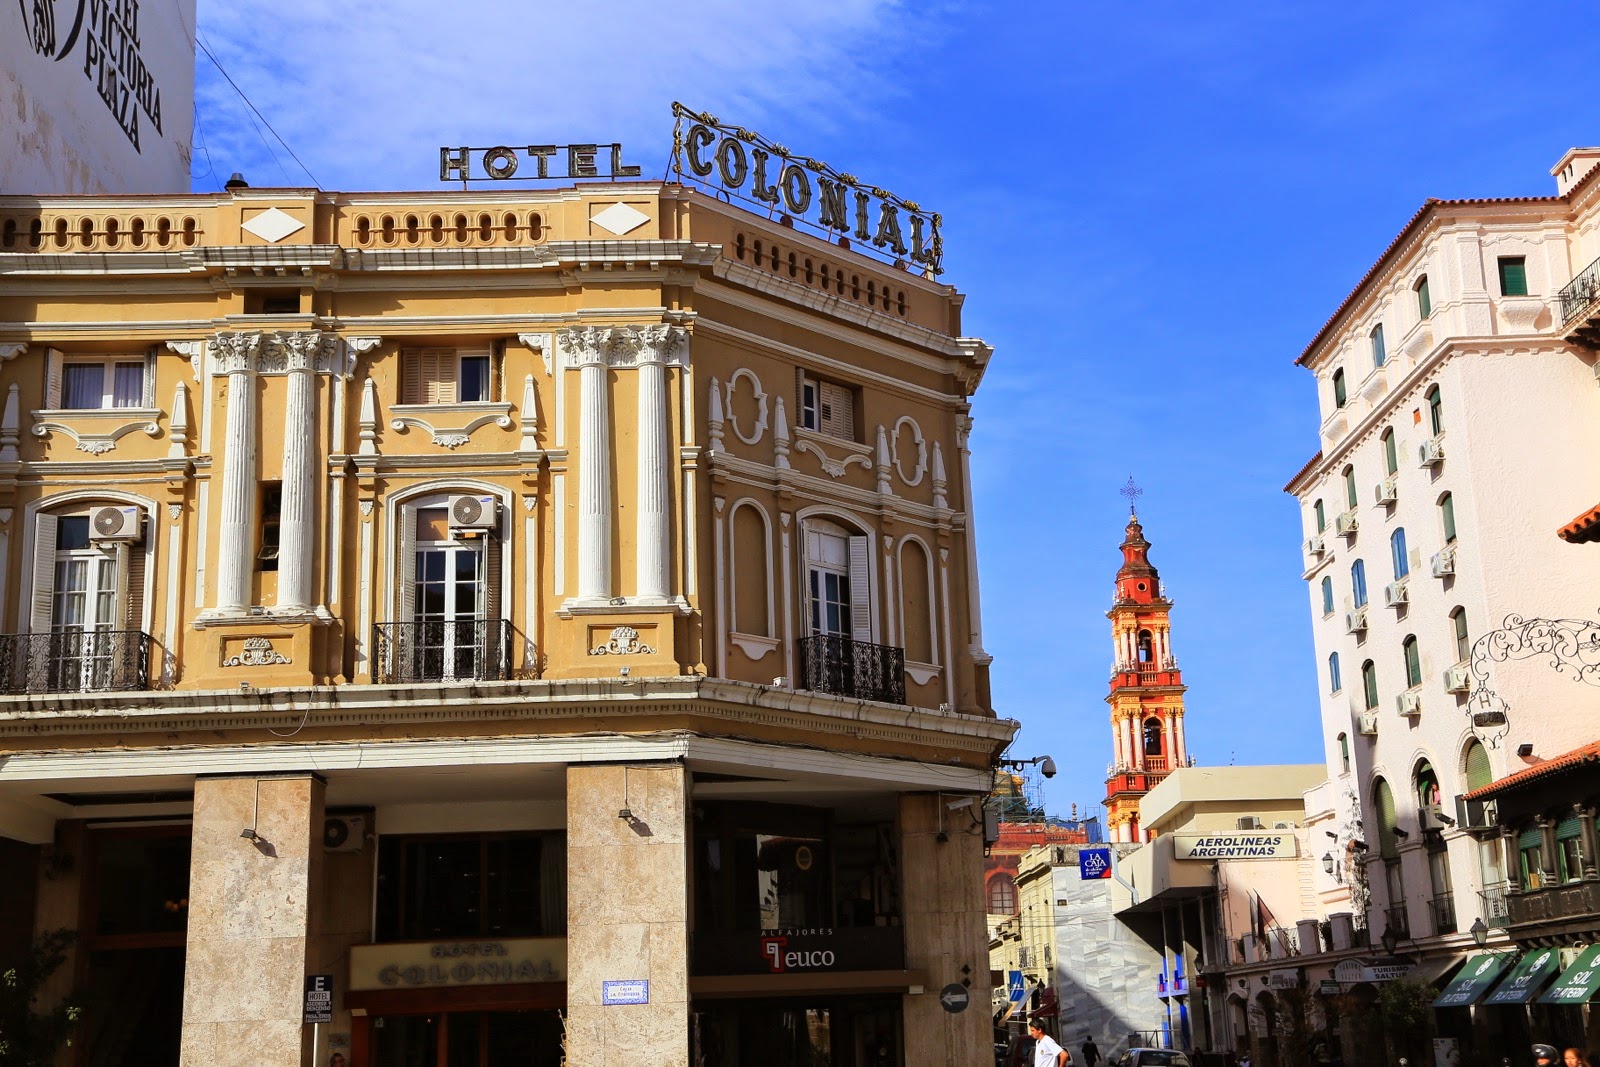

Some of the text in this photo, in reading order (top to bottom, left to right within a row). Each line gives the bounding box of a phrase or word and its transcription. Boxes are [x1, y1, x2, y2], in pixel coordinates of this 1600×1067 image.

[84, 28, 141, 155] PLAZA
[440, 143, 641, 181] HOTEL
[684, 124, 935, 264] COLONIAL
[1196, 837, 1281, 847] AEROLINEAS
[1089, 853, 1102, 861] LA
[1189, 847, 1275, 857] ARGENTINAS
[1084, 859, 1107, 869] CAJA
[761, 928, 833, 937] ALFAJORES
[430, 943, 508, 958] HOTEL
[377, 959, 561, 986] COLONIAL
[1372, 966, 1409, 974] TURISMO
[315, 977, 324, 991] E
[1510, 976, 1532, 988] SOL
[1568, 971, 1593, 985] SOL
[1457, 979, 1477, 991] SOL
[1549, 988, 1588, 998] PLATERIA
